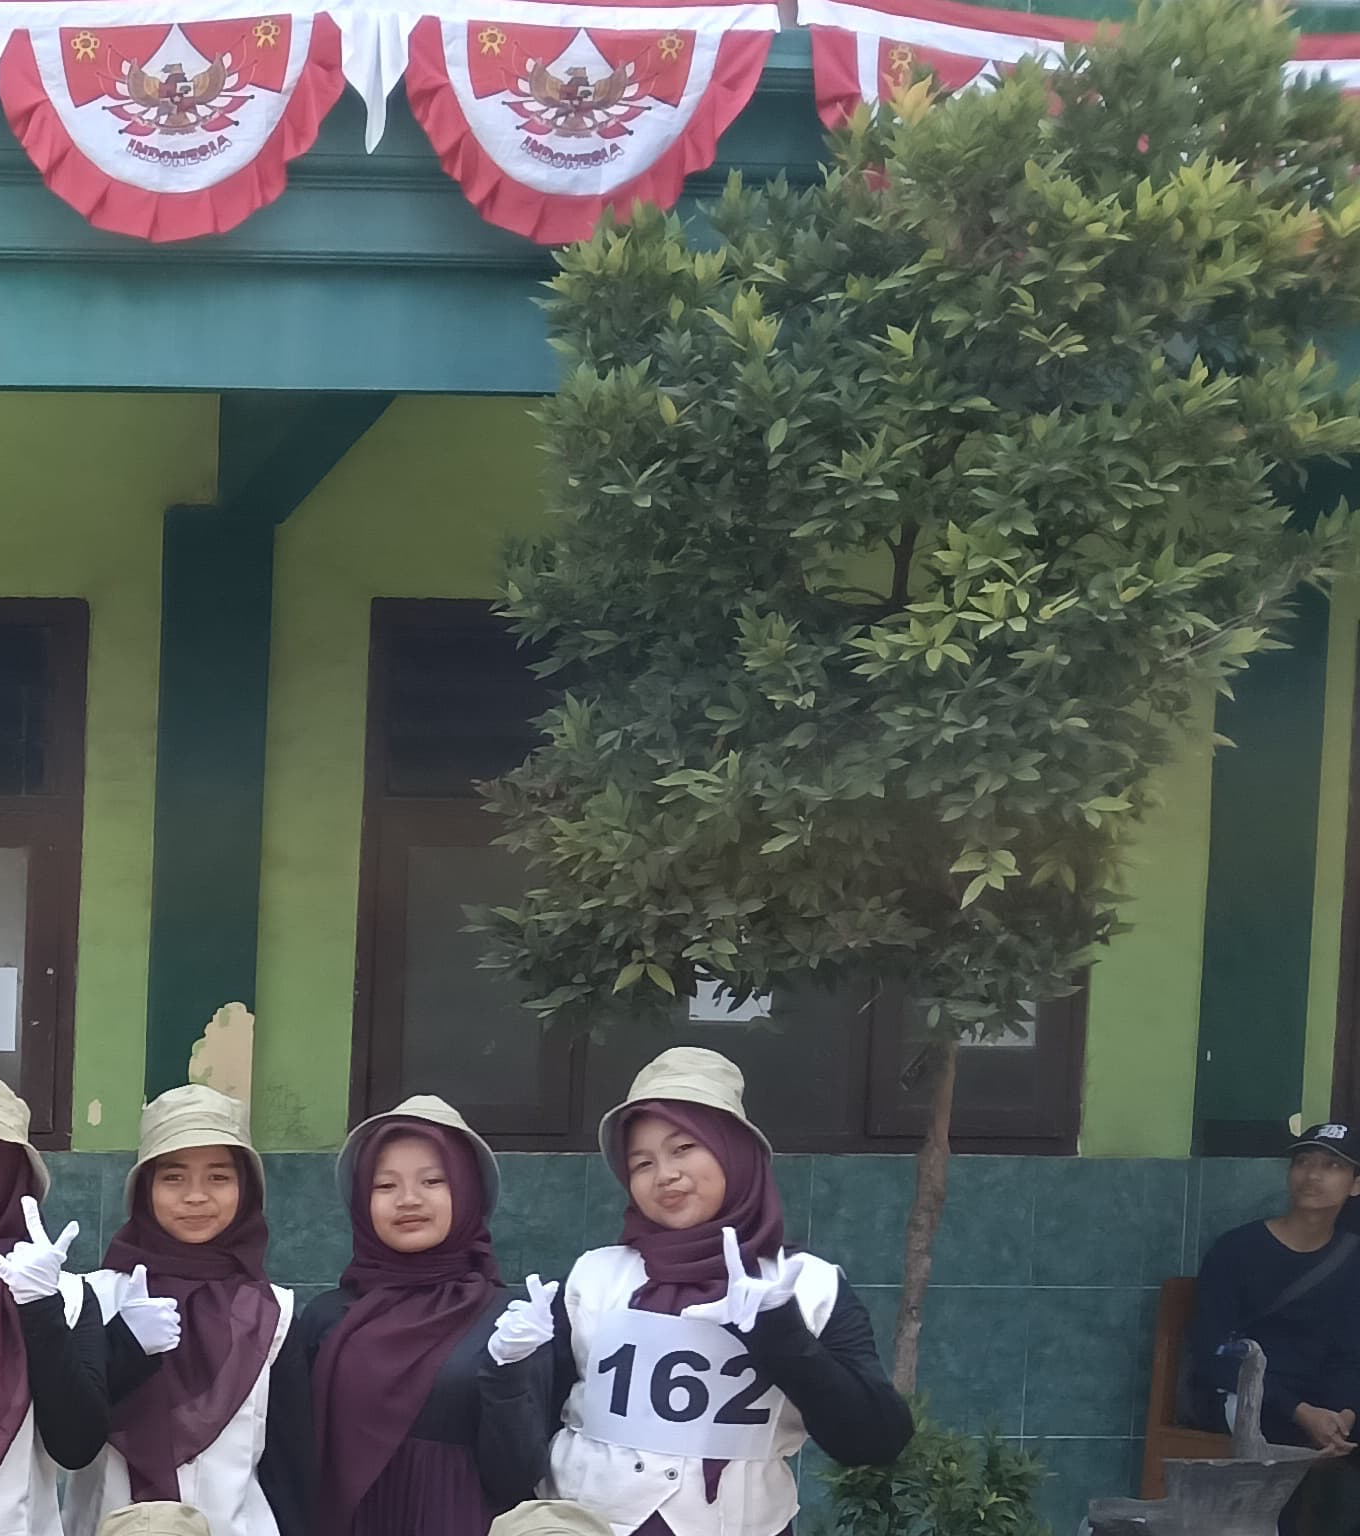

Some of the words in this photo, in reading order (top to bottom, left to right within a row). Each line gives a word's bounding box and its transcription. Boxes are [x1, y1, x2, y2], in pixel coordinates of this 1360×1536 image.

[126, 134, 232, 167] INDONESIA
[520, 135, 624, 169] INDONESIA
[597, 1343, 771, 1425] 162
